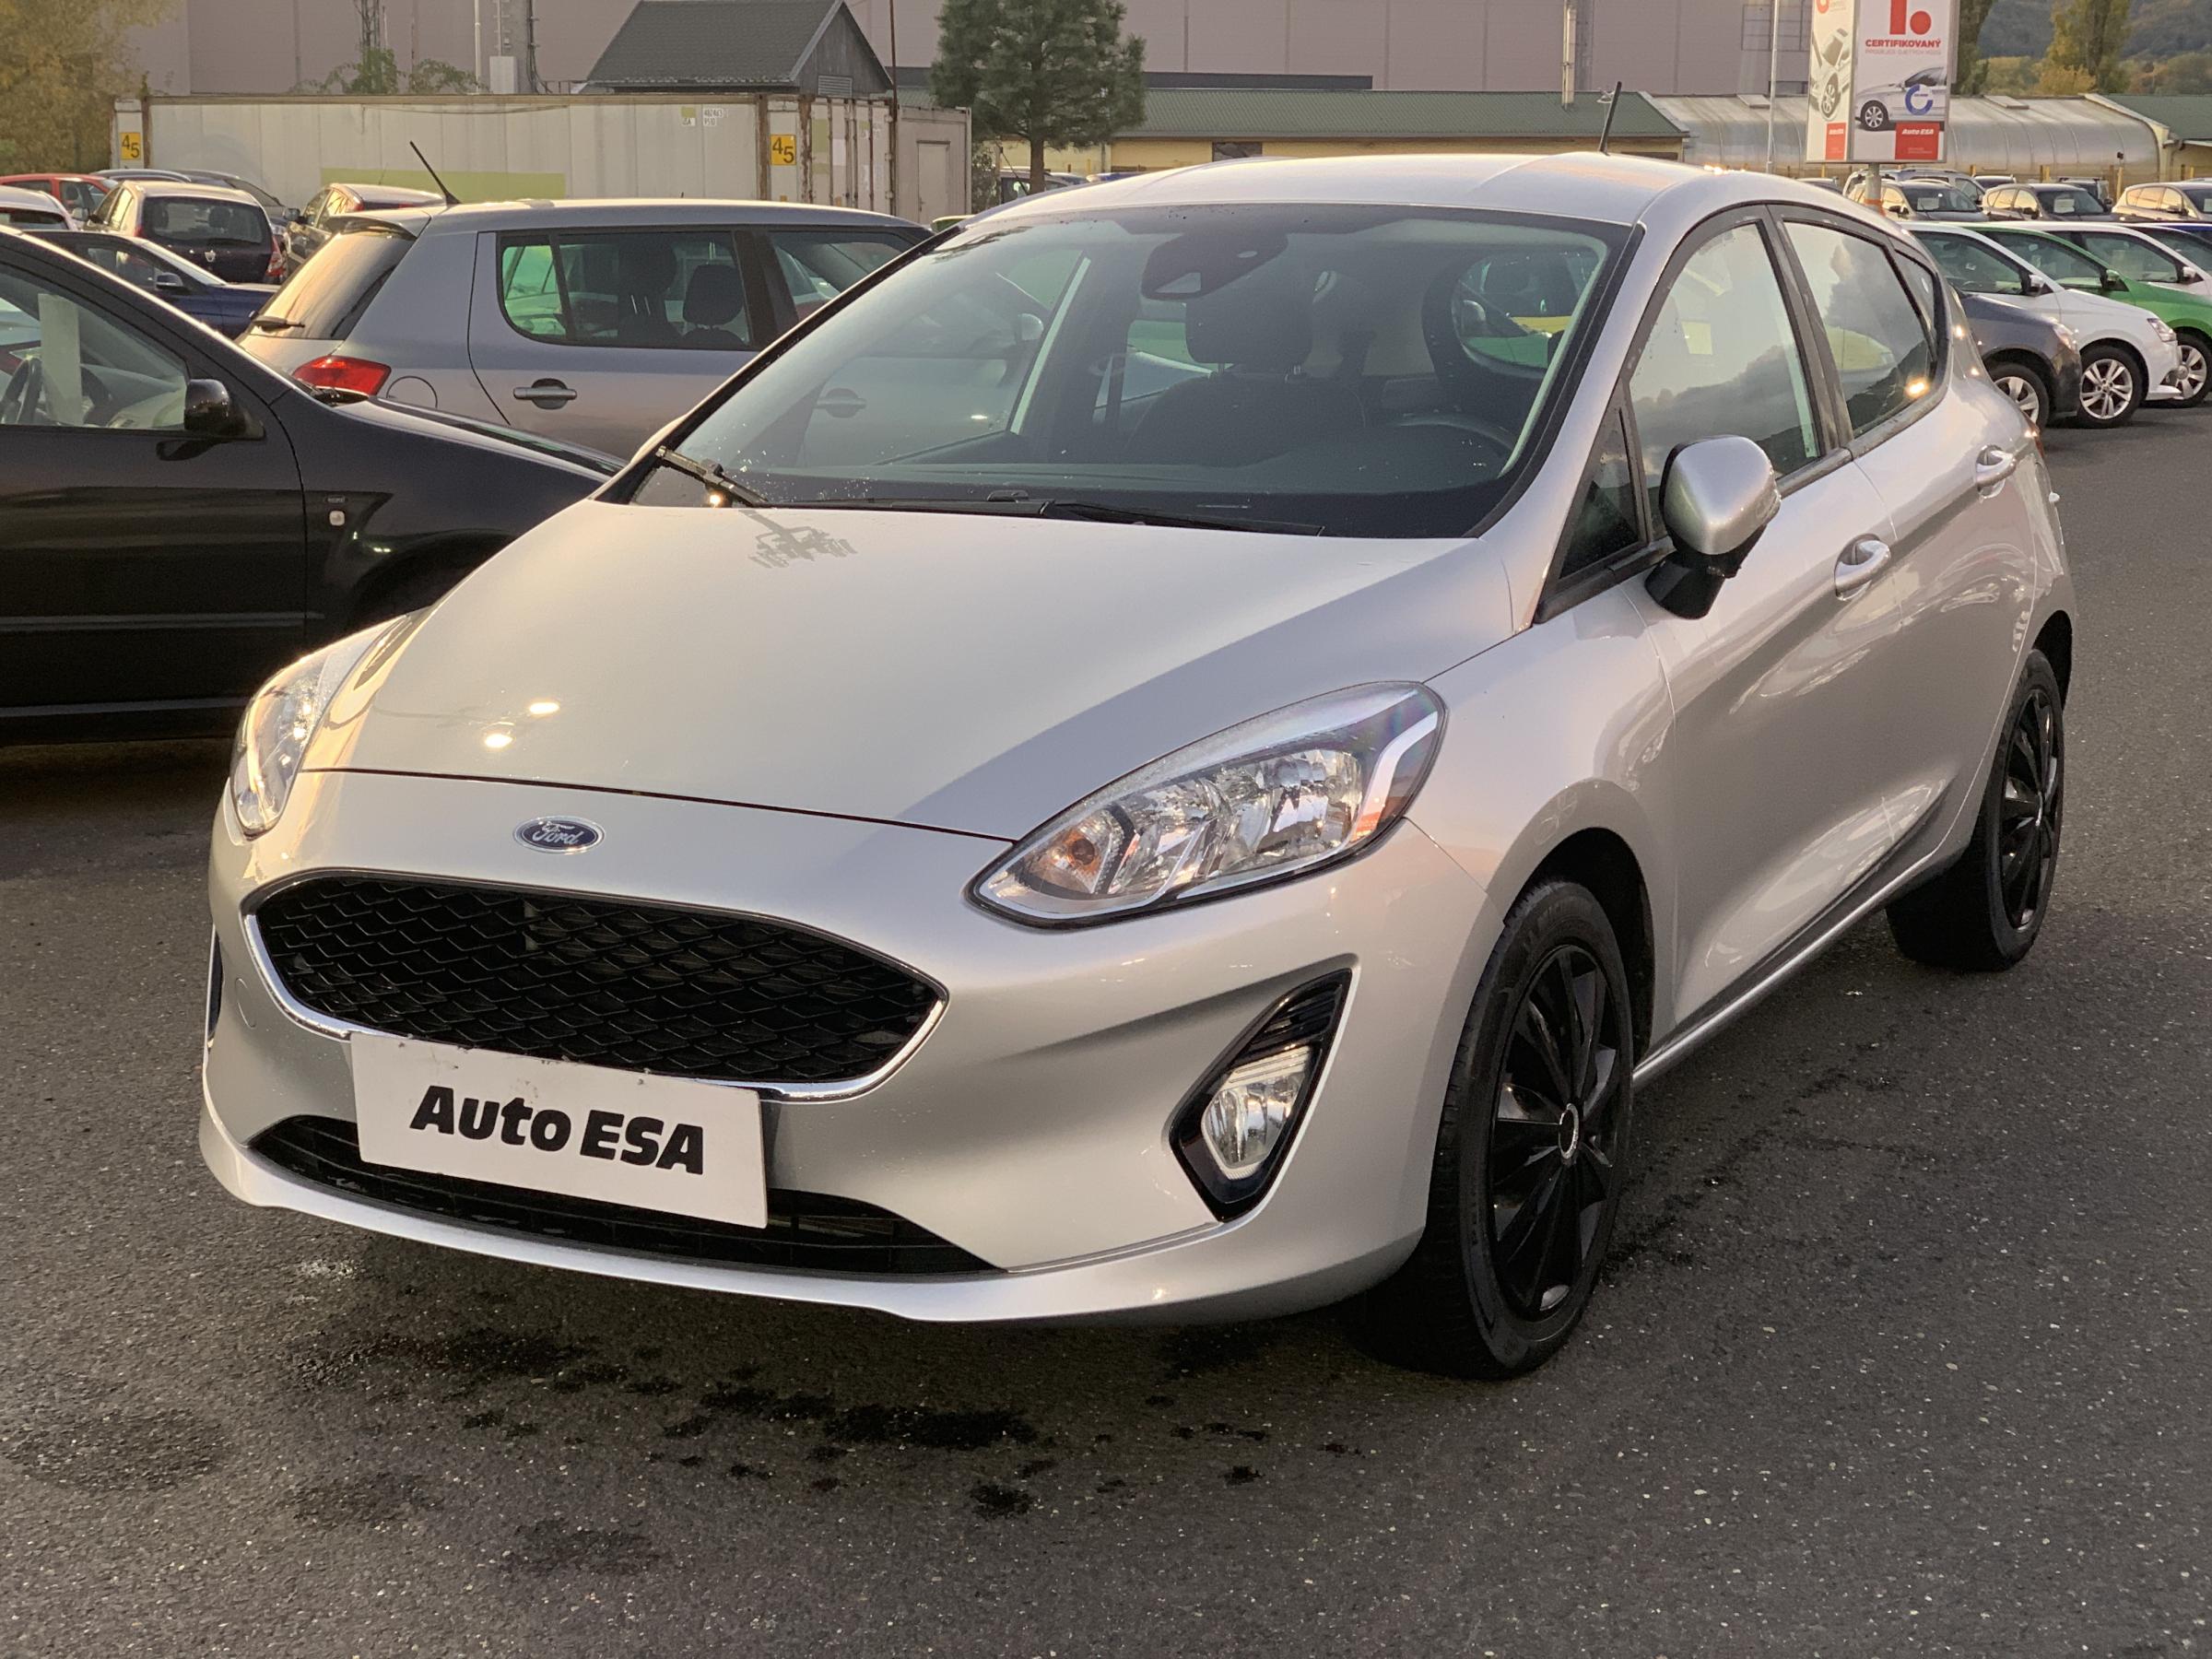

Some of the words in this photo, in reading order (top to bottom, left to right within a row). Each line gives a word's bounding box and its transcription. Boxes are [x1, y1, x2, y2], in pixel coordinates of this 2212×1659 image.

[1865, 39, 1941, 48] CERTIFIKOVANÝ
[122, 135, 140, 159] 45
[771, 136, 794, 163] 45
[532, 821, 584, 845] Ford
[409, 1085, 571, 1152] Auto
[580, 1110, 703, 1175] ESA
